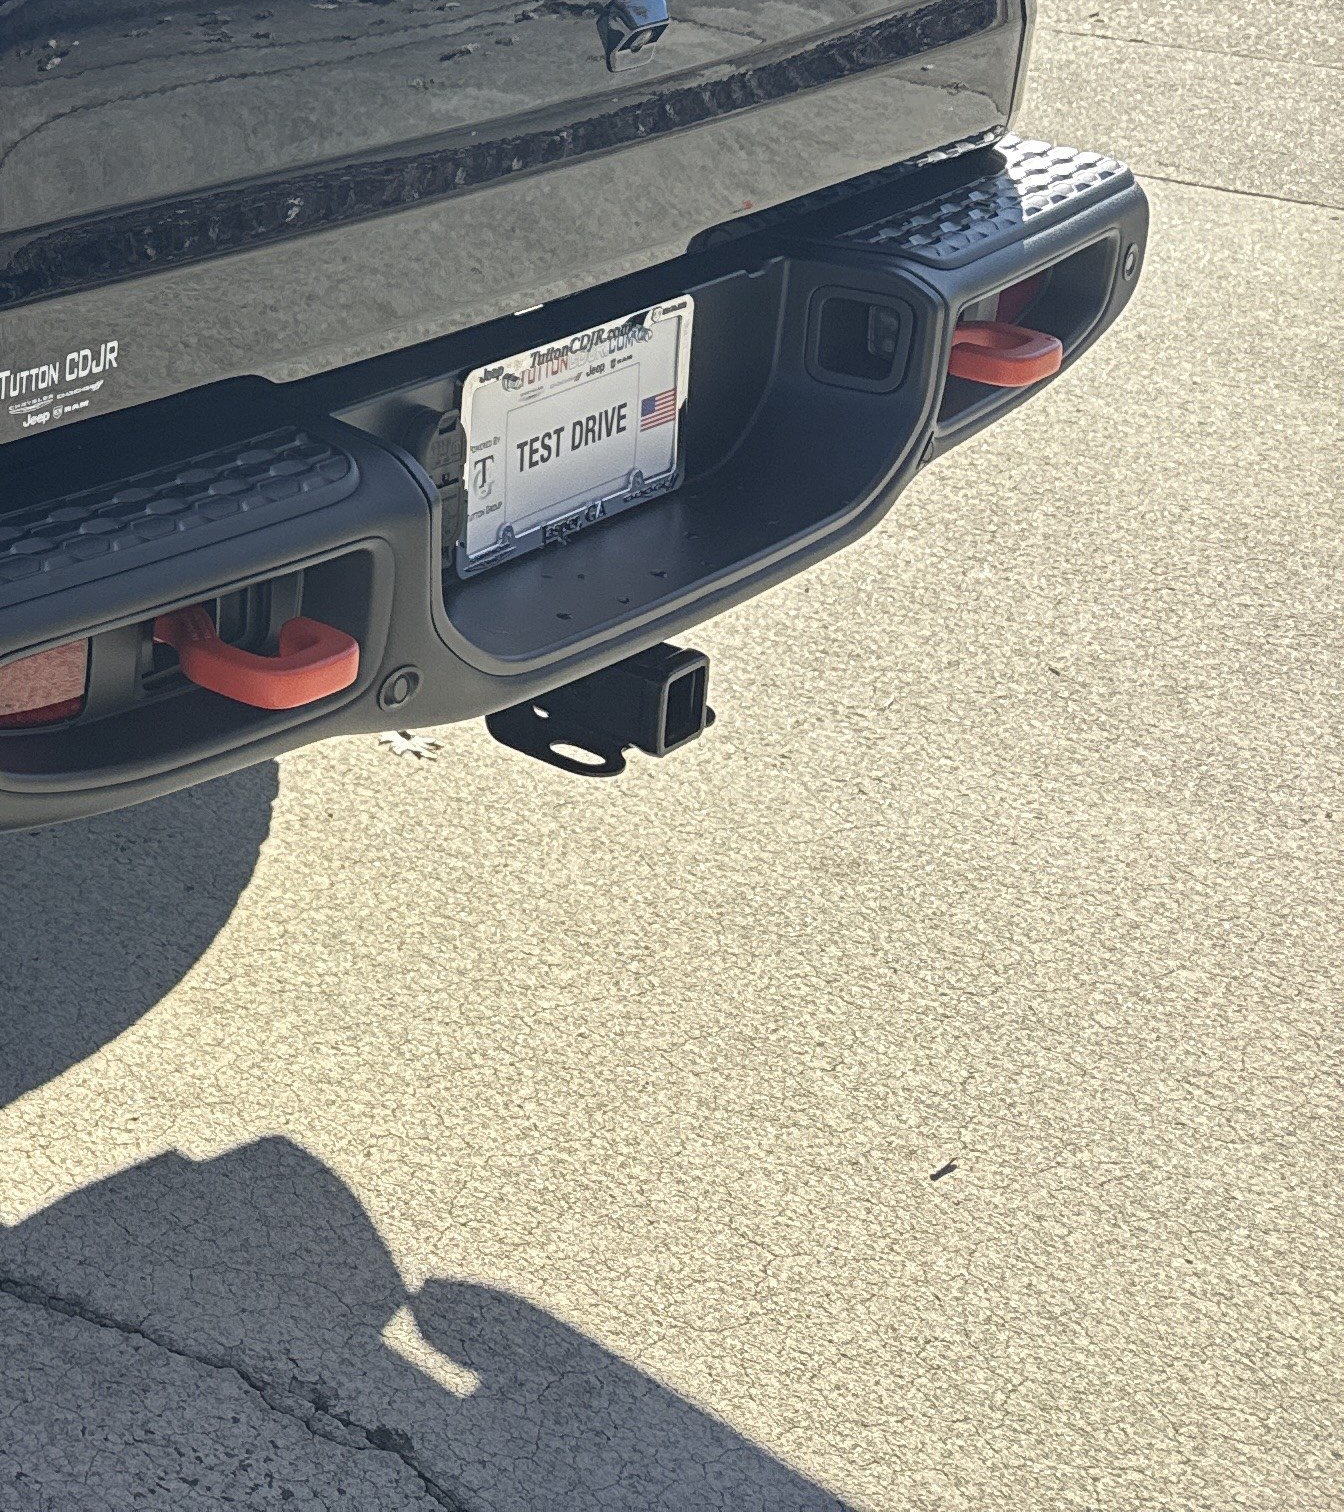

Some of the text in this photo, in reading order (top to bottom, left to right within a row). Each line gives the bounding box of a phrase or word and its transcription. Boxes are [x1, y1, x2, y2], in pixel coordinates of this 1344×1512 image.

[66, 340, 118, 381] CDJR
[23, 411, 50, 427] Jeep
[516, 402, 628, 473] TEST DRIVE
